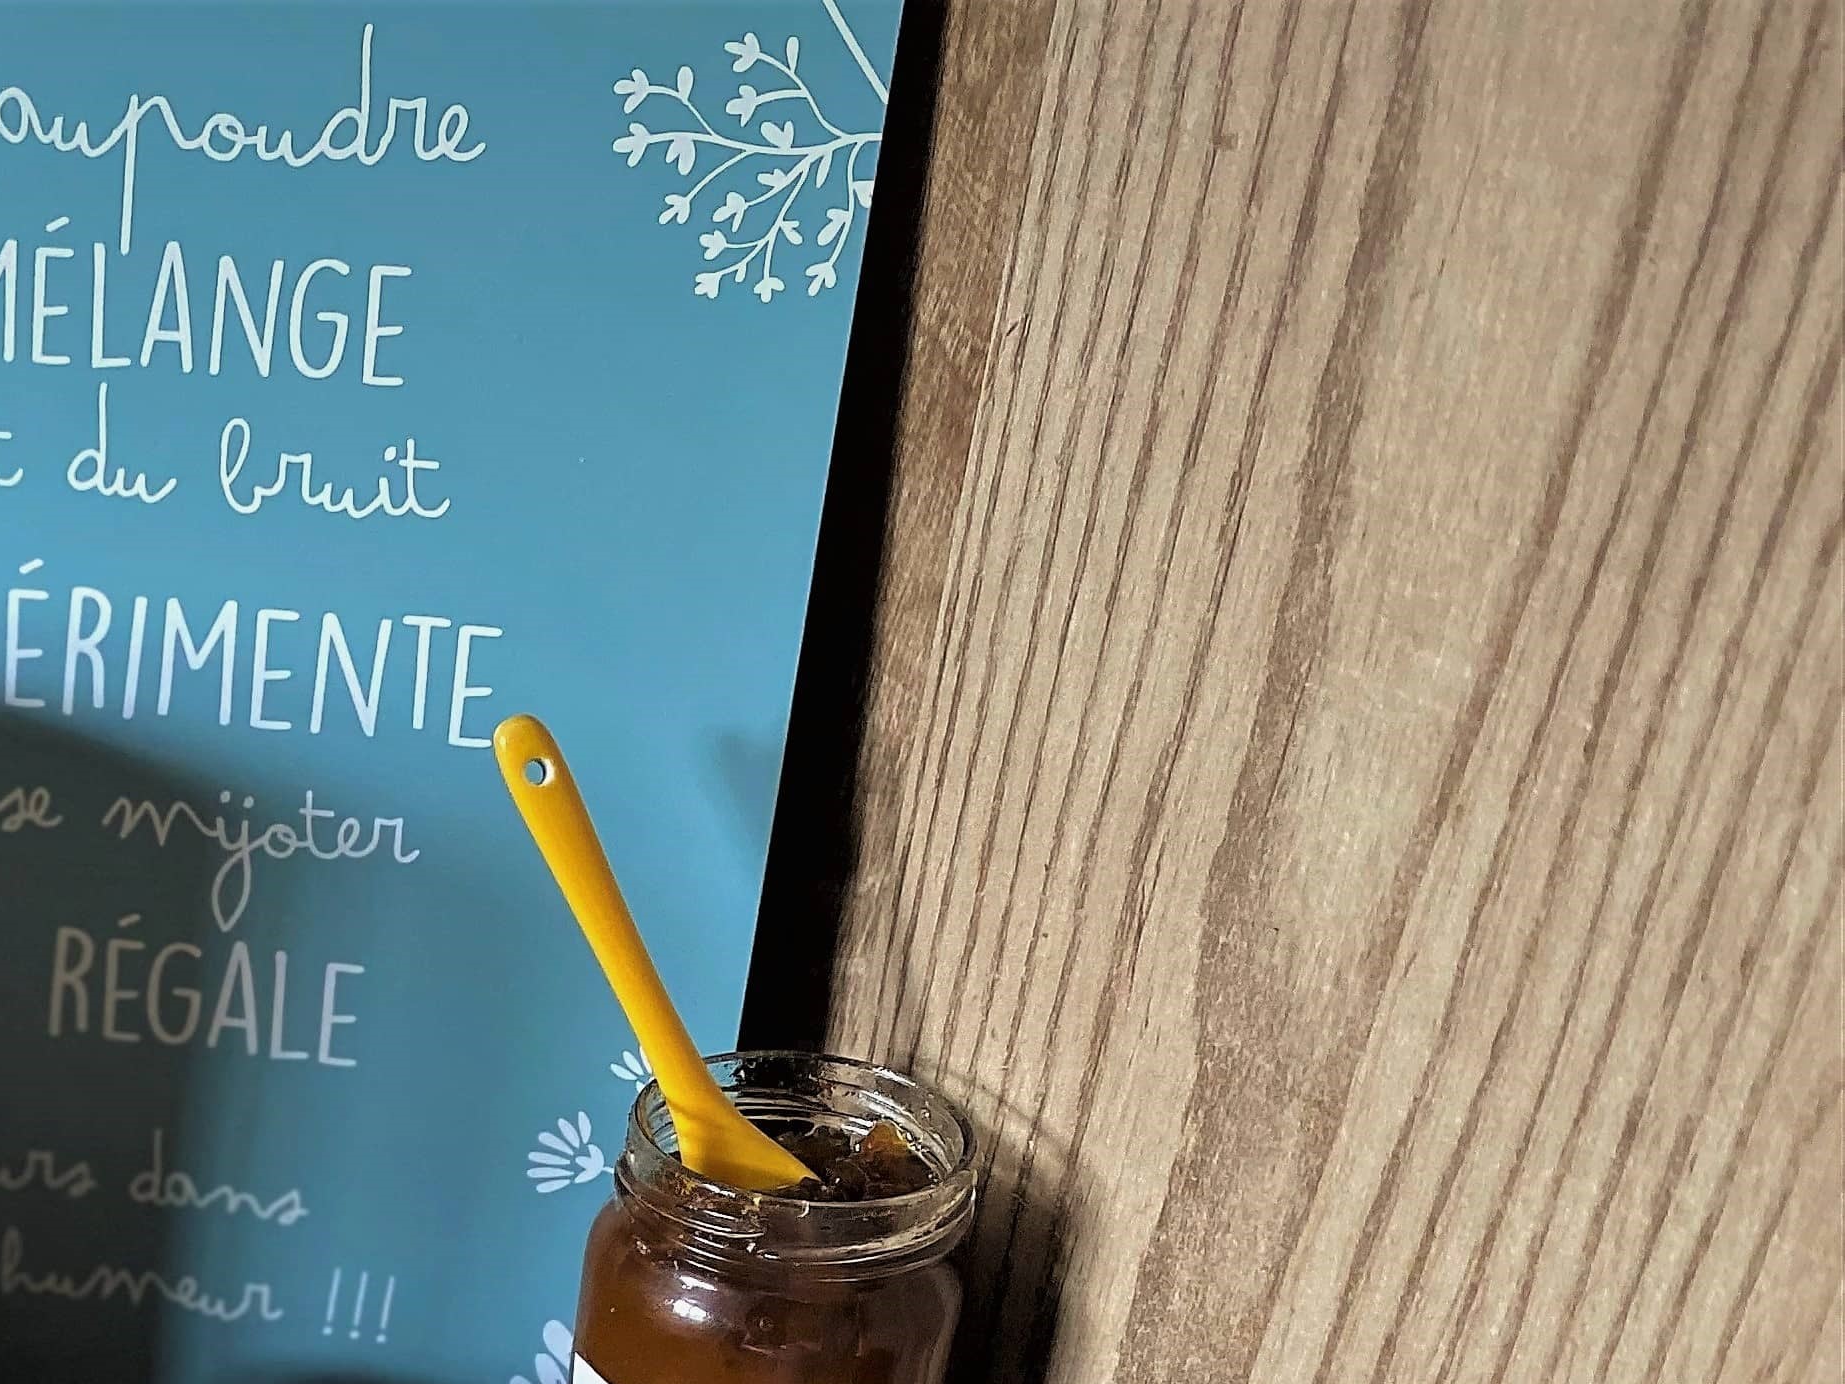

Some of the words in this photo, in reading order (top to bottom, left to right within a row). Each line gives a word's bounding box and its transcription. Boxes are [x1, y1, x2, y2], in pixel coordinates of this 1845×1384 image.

[66, 381, 178, 504] du
[219, 417, 451, 519] bruit
[101, 789, 421, 933] mijoter
[47, 912, 367, 1068] RÉGALE
[129, 1127, 310, 1226] dans
[0, 1224, 285, 1322] humeur
[321, 1265, 396, 1345] !!!
